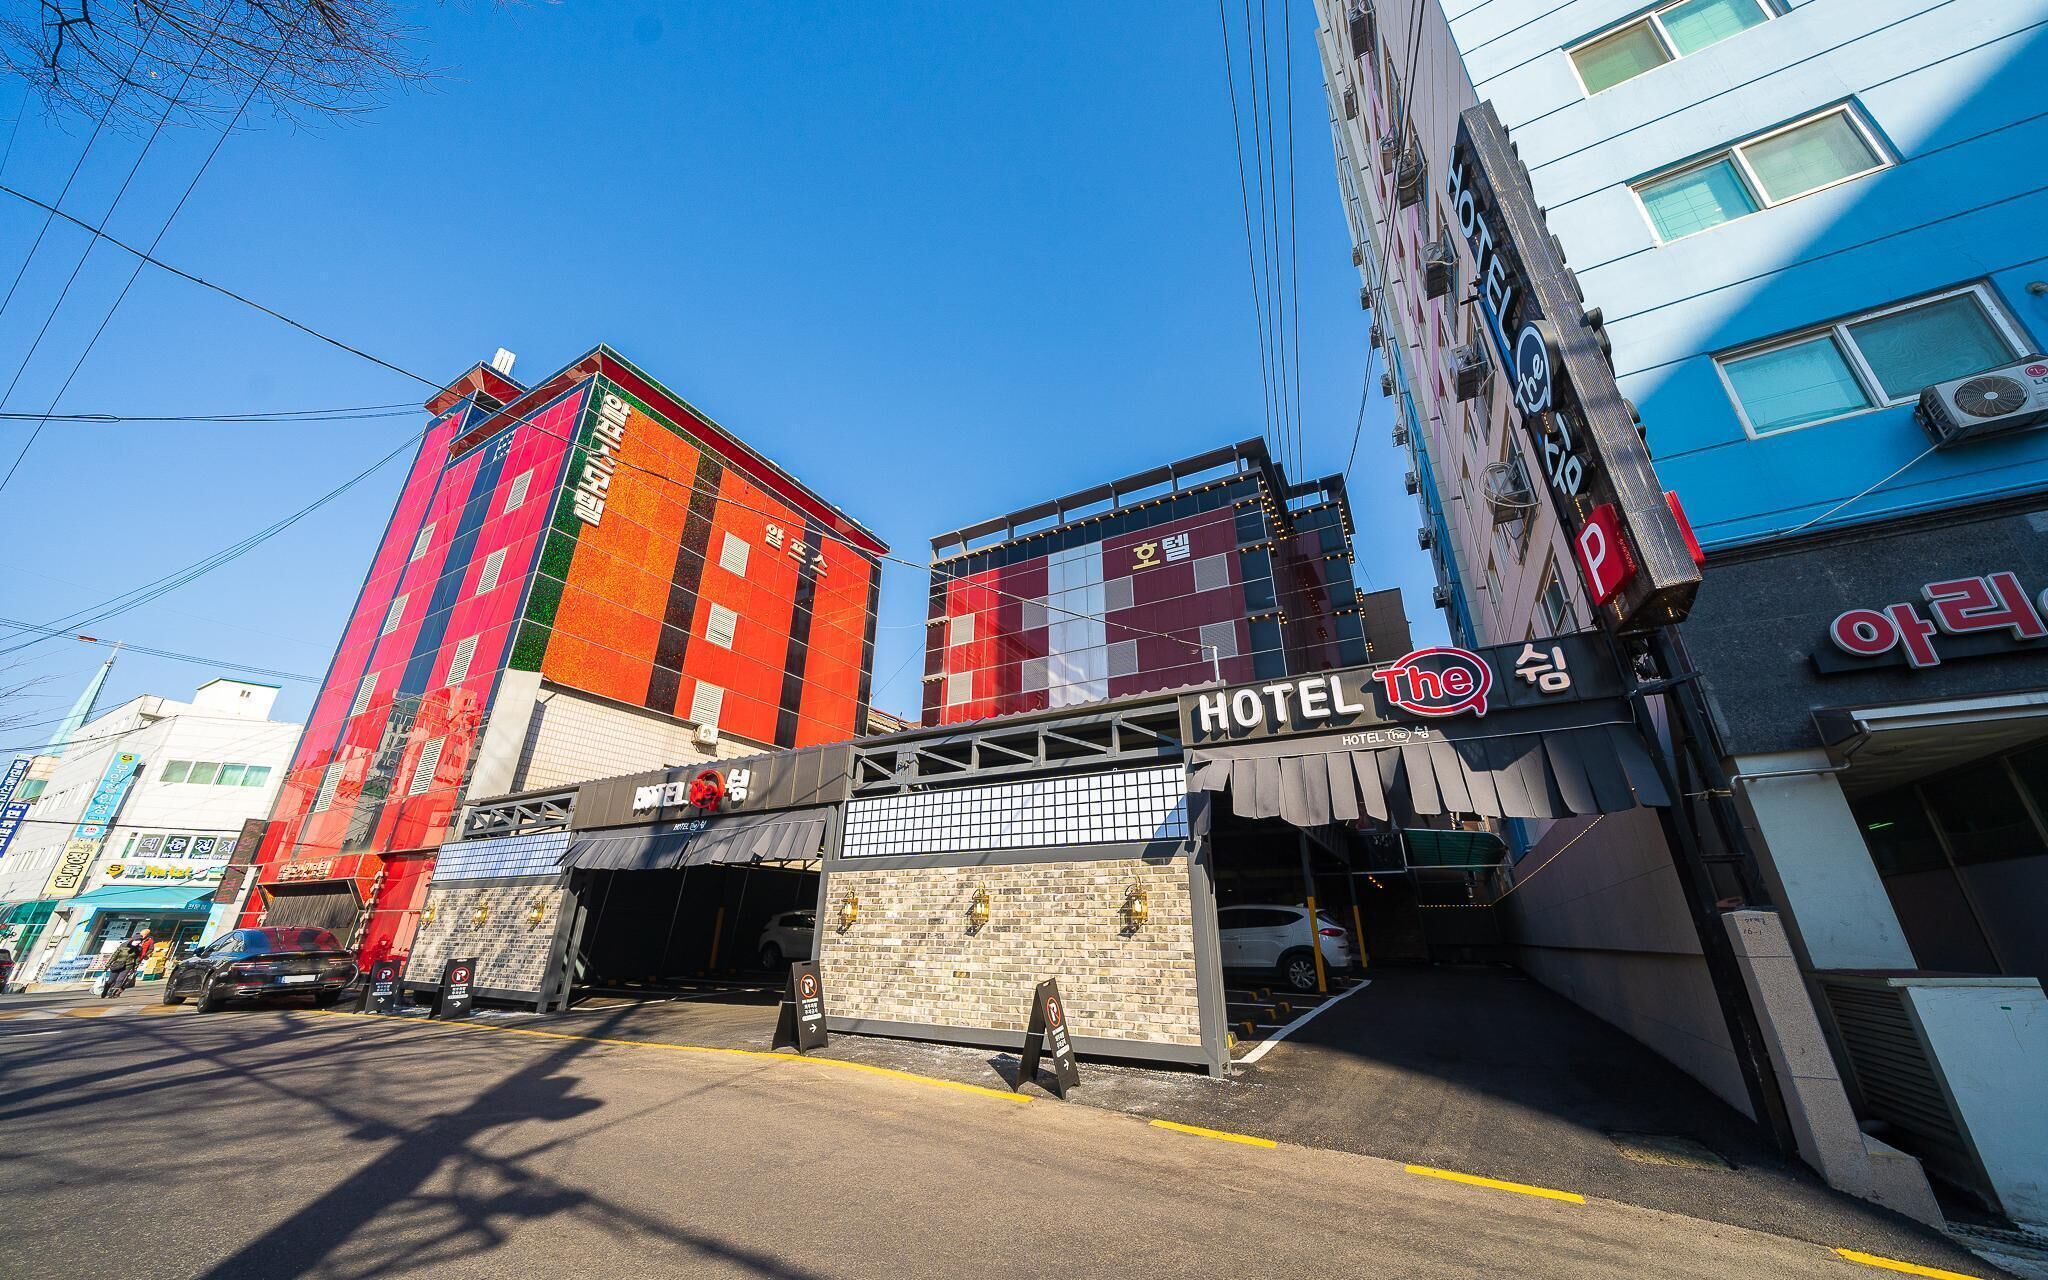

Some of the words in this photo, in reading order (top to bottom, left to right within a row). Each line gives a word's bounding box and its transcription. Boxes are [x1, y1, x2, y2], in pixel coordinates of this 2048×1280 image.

[1446, 145, 1511, 350] HOTEL
[573, 393, 632, 528] 알프스모텔
[765, 523, 828, 577] 알프스
[1133, 532, 1191, 570] 호텔
[1581, 522, 1606, 598] P
[1831, 571, 2048, 669] 아리
[1199, 675, 1364, 732] HOTEL
[1372, 664, 1476, 705] The
[1342, 733, 1385, 746] HOTEL
